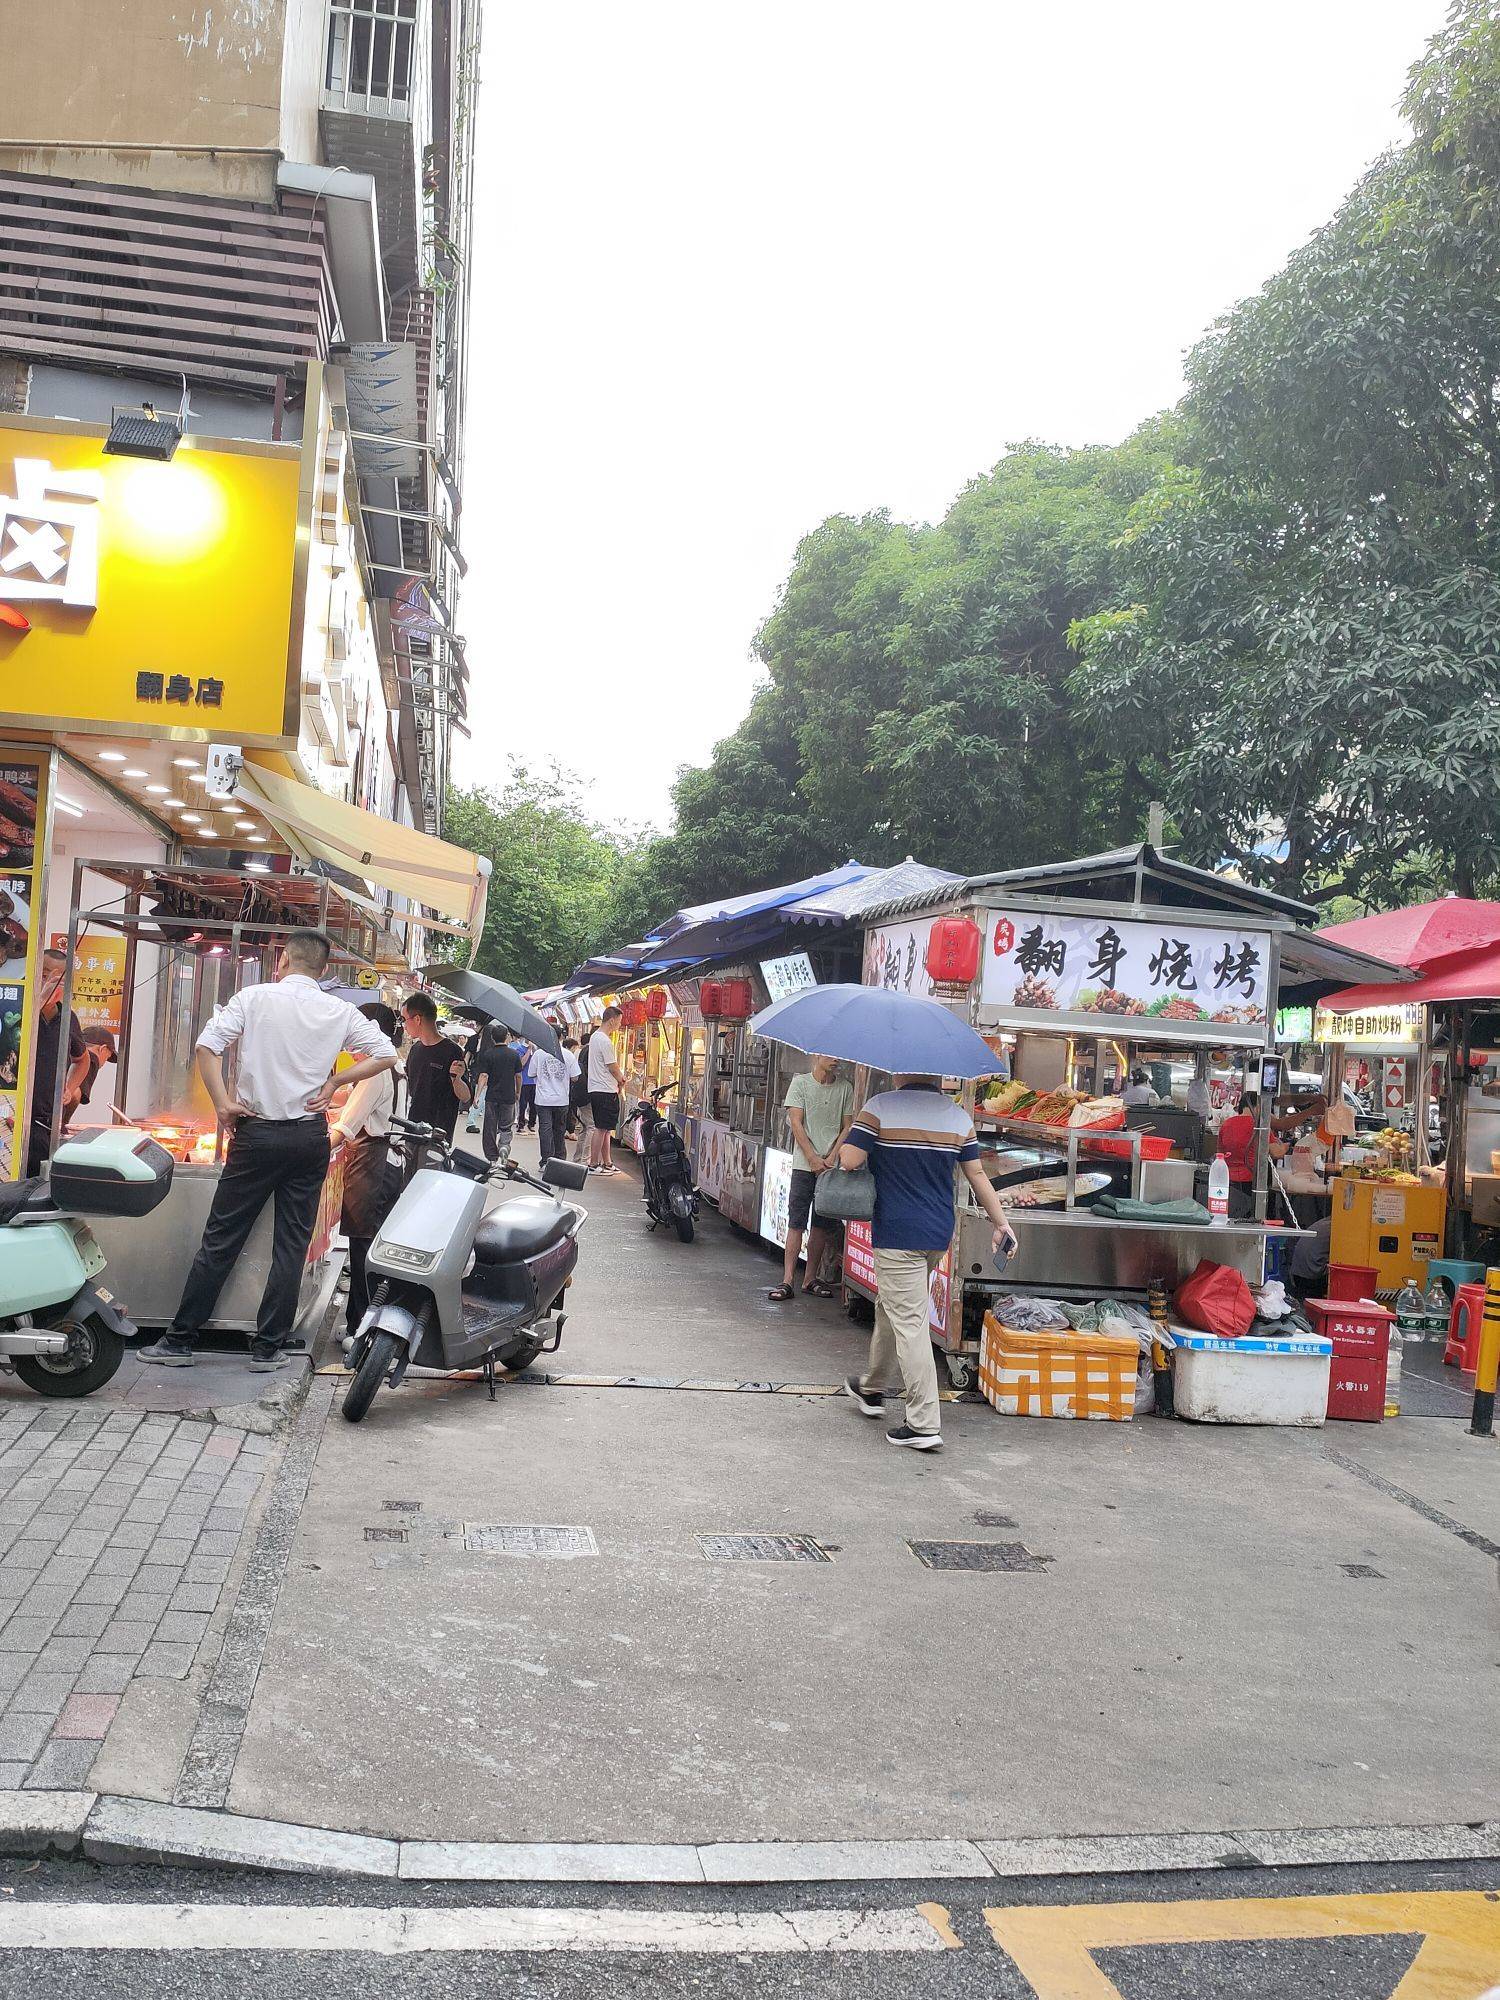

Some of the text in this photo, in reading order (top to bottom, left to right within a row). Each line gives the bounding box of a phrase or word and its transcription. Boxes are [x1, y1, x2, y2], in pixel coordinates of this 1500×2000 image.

[136, 671, 223, 705] 翻身店
[0, 770, 32, 784] 鸭头
[1014, 925, 1262, 999] 翻身烧烤
[1331, 1015, 1401, 1036] 靓坤自助炒粉
[1333, 1323, 1377, 1336] 灭火器箱
[1336, 1381, 1369, 1392] 火警119
